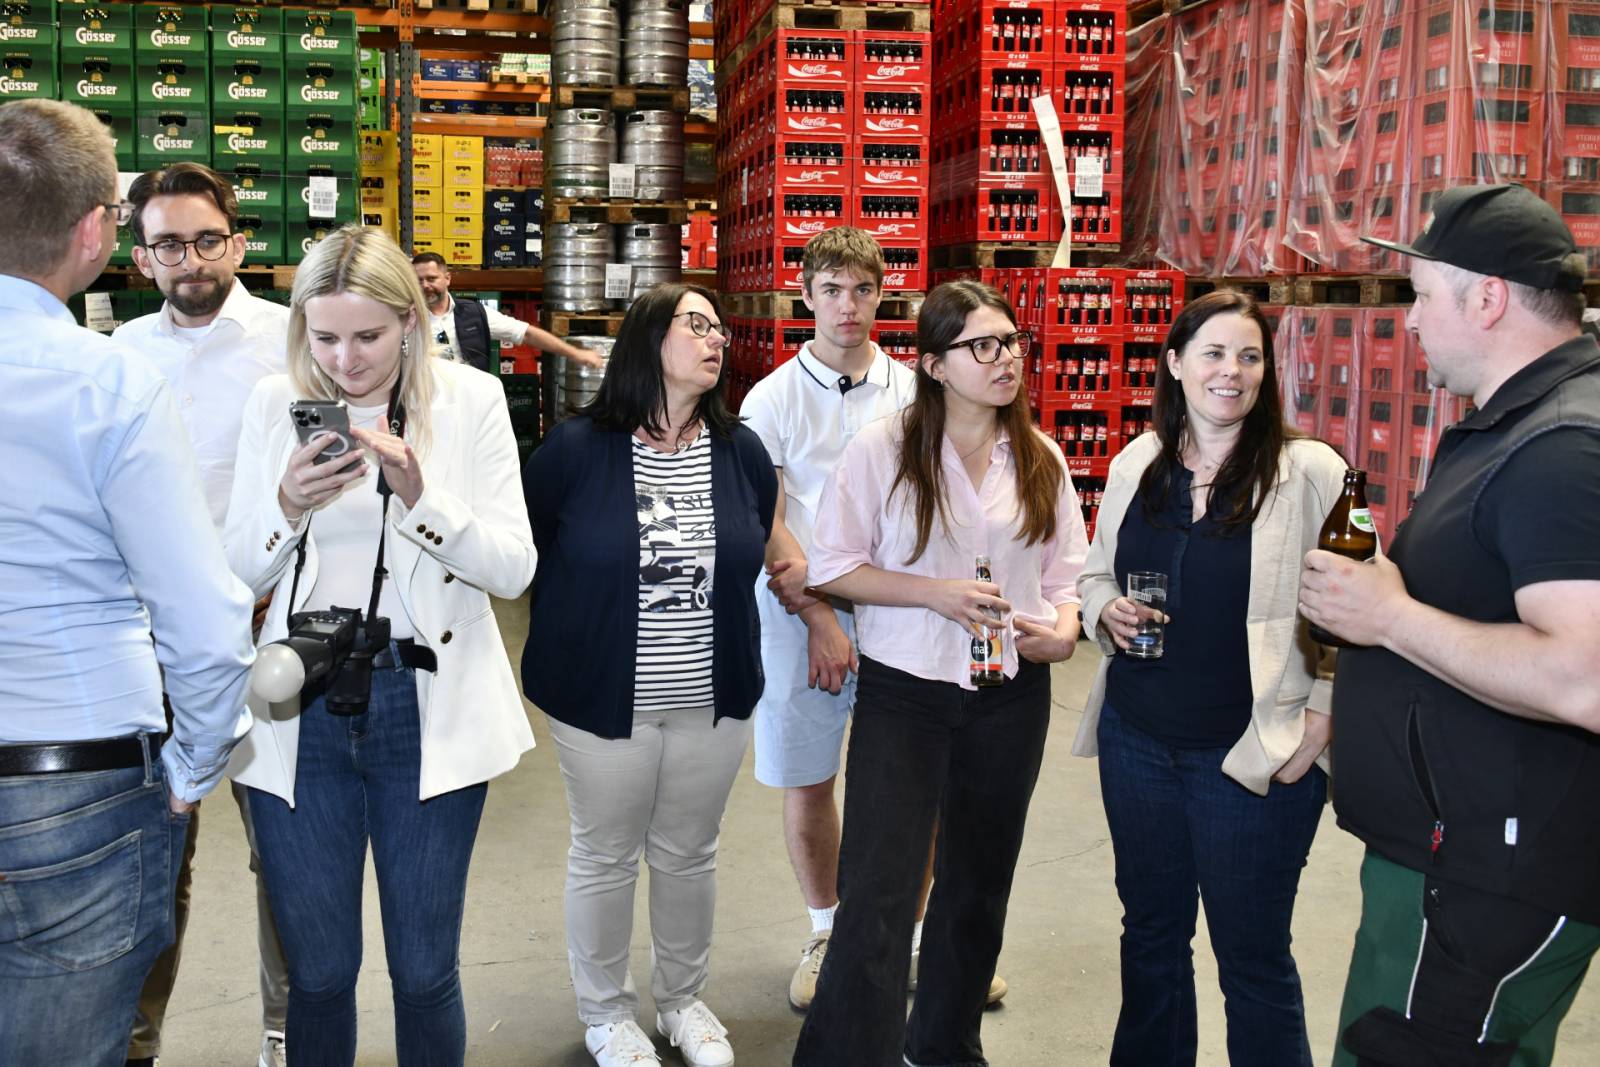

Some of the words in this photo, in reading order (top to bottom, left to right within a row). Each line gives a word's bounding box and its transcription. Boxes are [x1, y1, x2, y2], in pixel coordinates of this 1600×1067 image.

[0, 23, 38, 40] Gösser
[76, 27, 116, 44] Gösser
[151, 30, 190, 47] Gösser
[227, 31, 266, 48] Gösser
[300, 34, 339, 51] Gösser
[801, 64, 828, 74] Coca-Cola
[877, 66, 905, 76] Coca-Cola
[0, 76, 39, 94] Gösser
[77, 80, 117, 97] Gösser
[152, 82, 191, 99] Gösser
[228, 82, 268, 100] Gösser
[301, 85, 339, 102] Gösser
[801, 117, 827, 127] Coca-Cola
[879, 119, 904, 128] Coca-Cola
[153, 134, 194, 151] Gösser
[228, 134, 268, 151] Gösser
[301, 136, 339, 153] Gösser
[878, 171, 904, 180] Coca-Cola
[800, 221, 825, 231] Coca-Cola
[246, 241, 268, 251] sser
